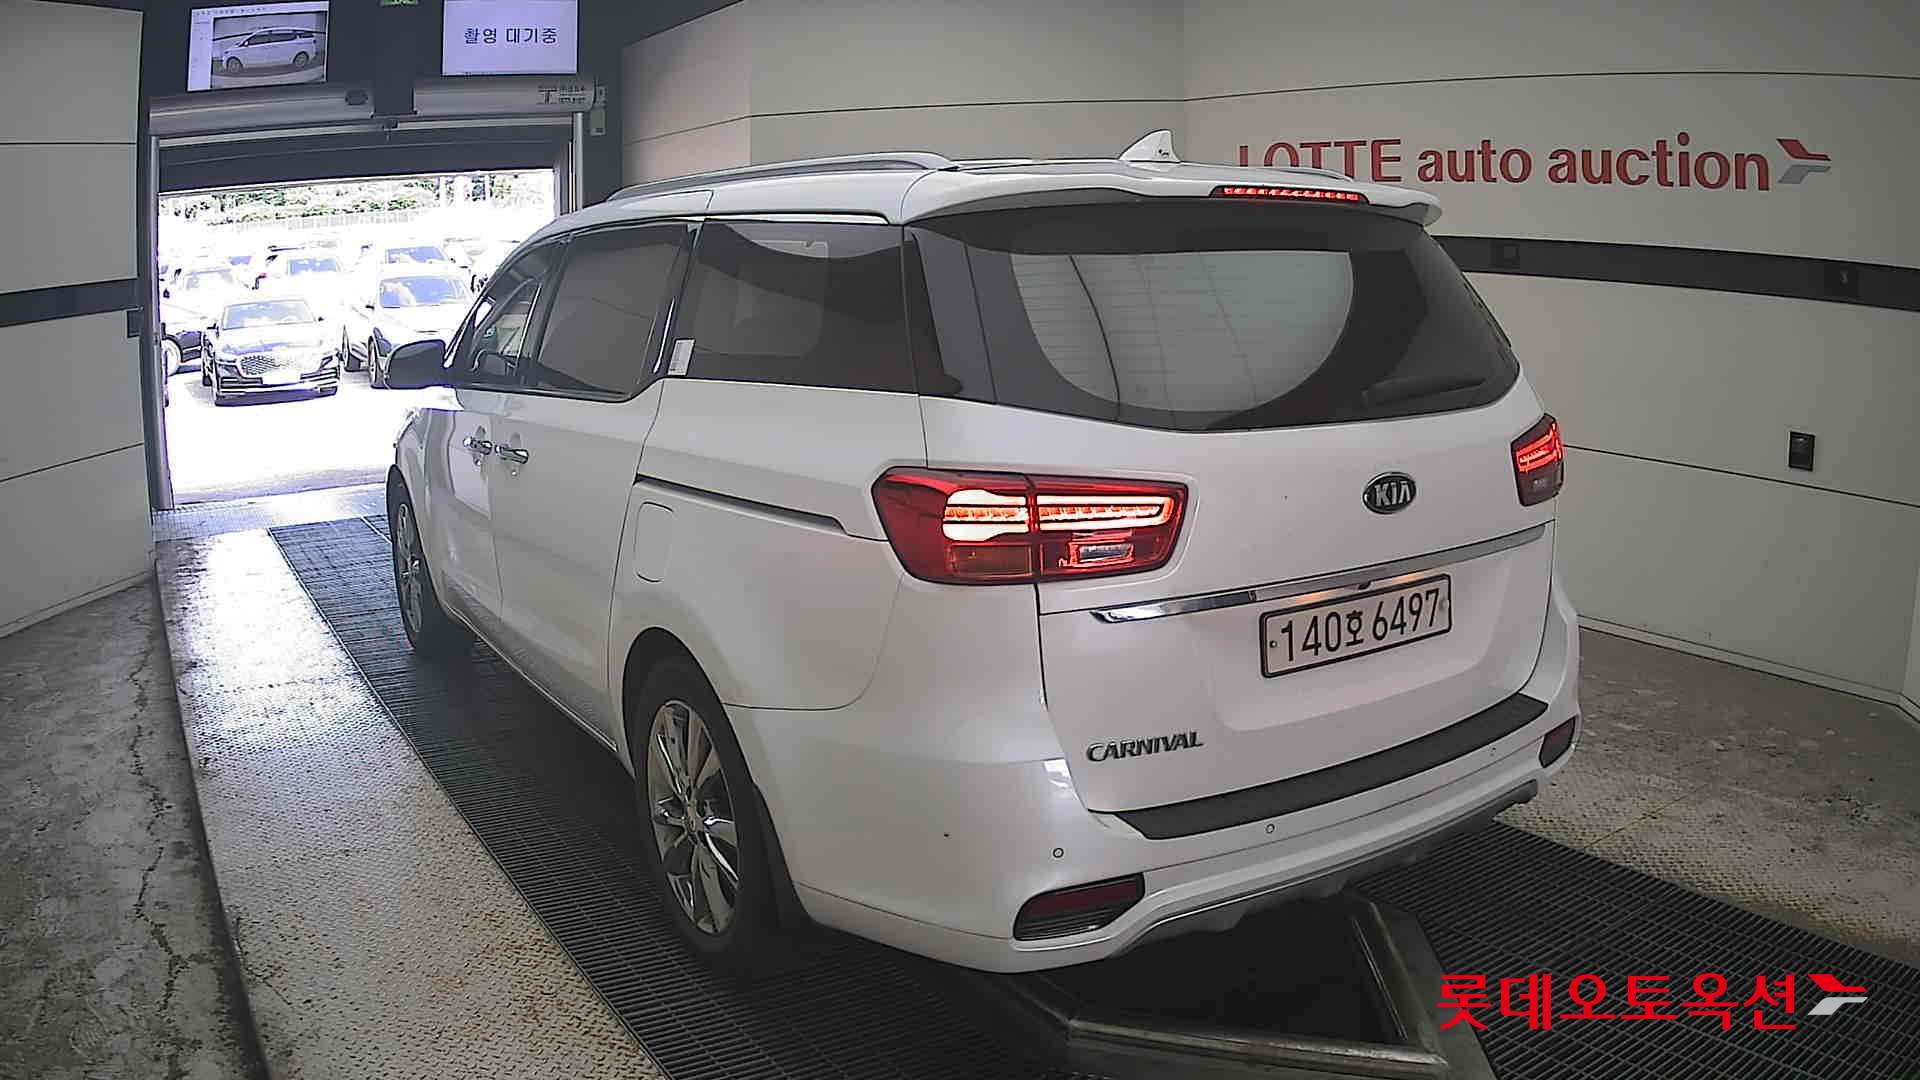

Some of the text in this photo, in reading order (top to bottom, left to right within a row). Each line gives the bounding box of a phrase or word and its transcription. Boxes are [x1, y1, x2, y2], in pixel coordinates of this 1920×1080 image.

[464, 27, 558, 44] 촬영 대기중
[1417, 138, 1532, 183] auto
[1548, 131, 1770, 191] auction
[1374, 480, 1411, 507] KIA
[1086, 731, 1204, 762] CARNIVAL
